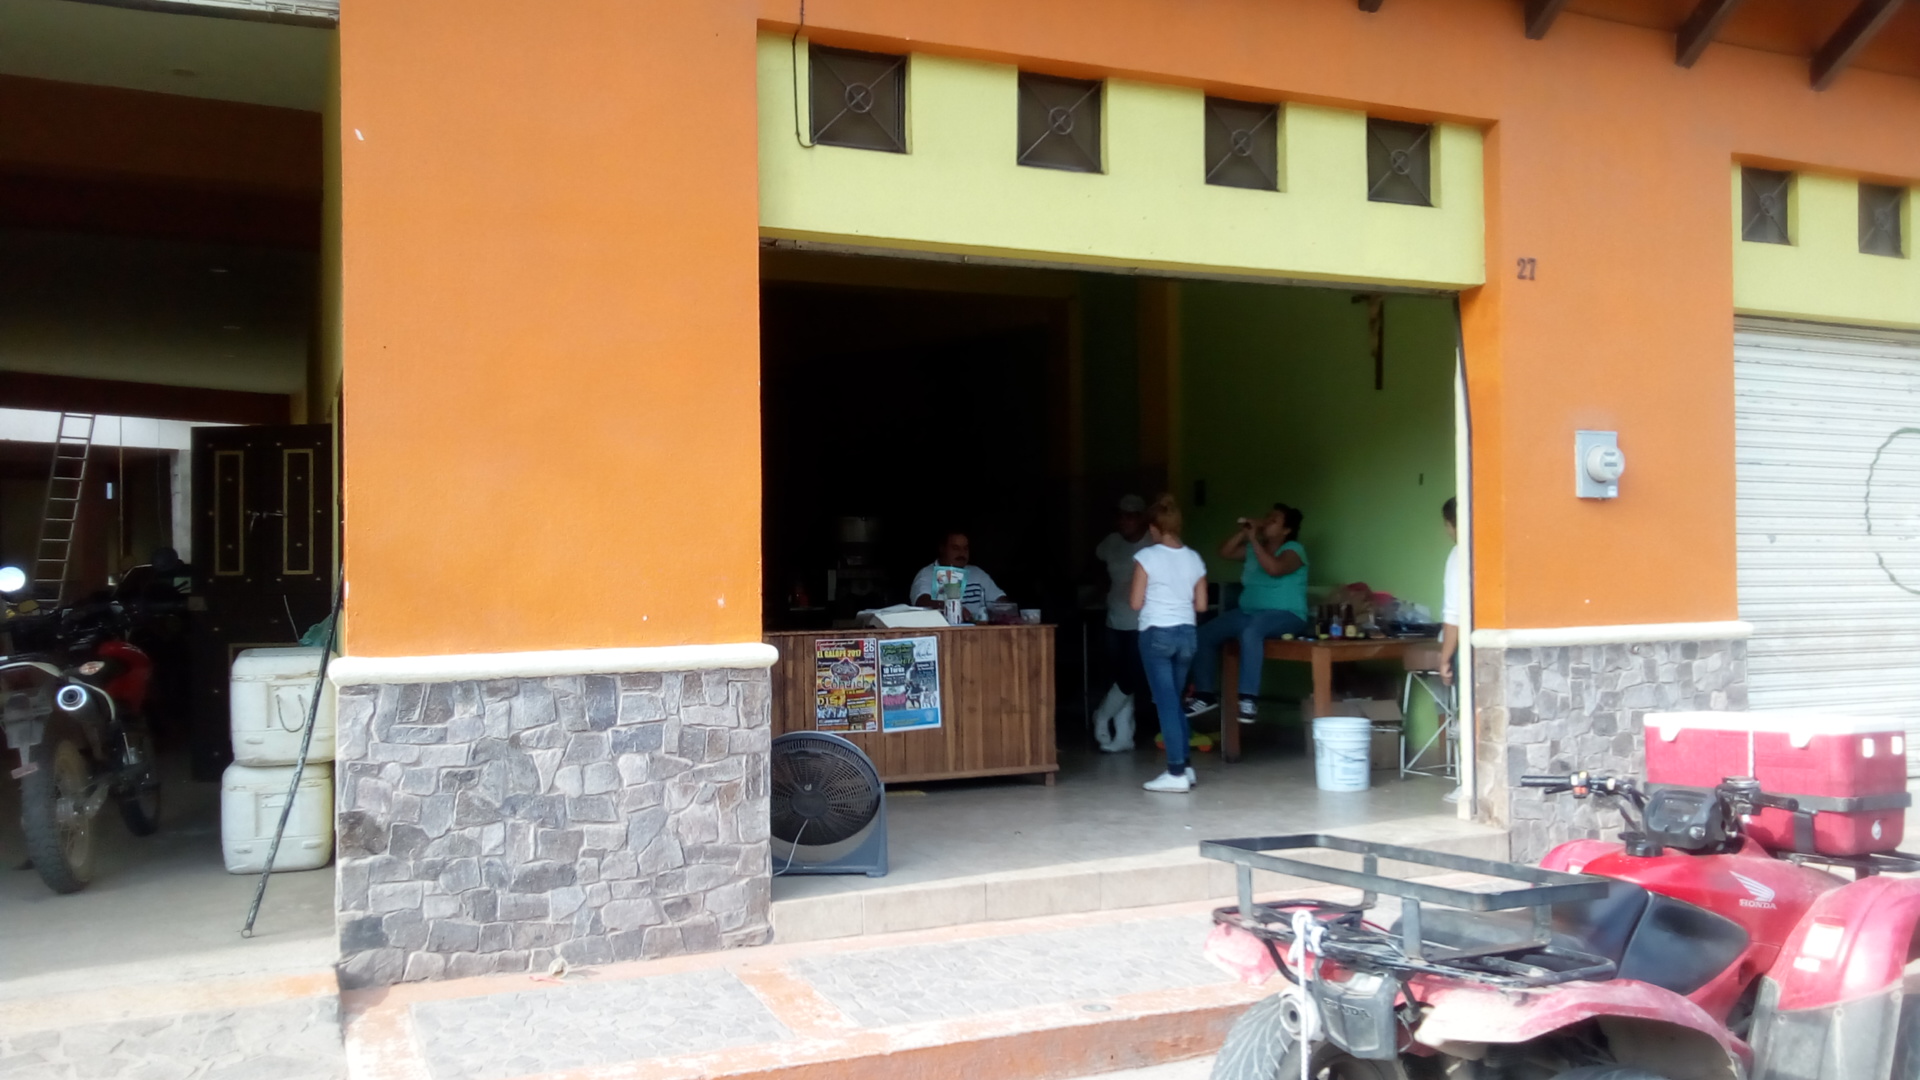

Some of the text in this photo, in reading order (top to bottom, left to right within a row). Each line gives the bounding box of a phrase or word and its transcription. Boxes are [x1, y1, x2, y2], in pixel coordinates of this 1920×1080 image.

[1517, 257, 1536, 281] 27
[847, 649, 862, 657] 2017
[864, 642, 875, 653] 26
[1739, 898, 1777, 910] HONDA
